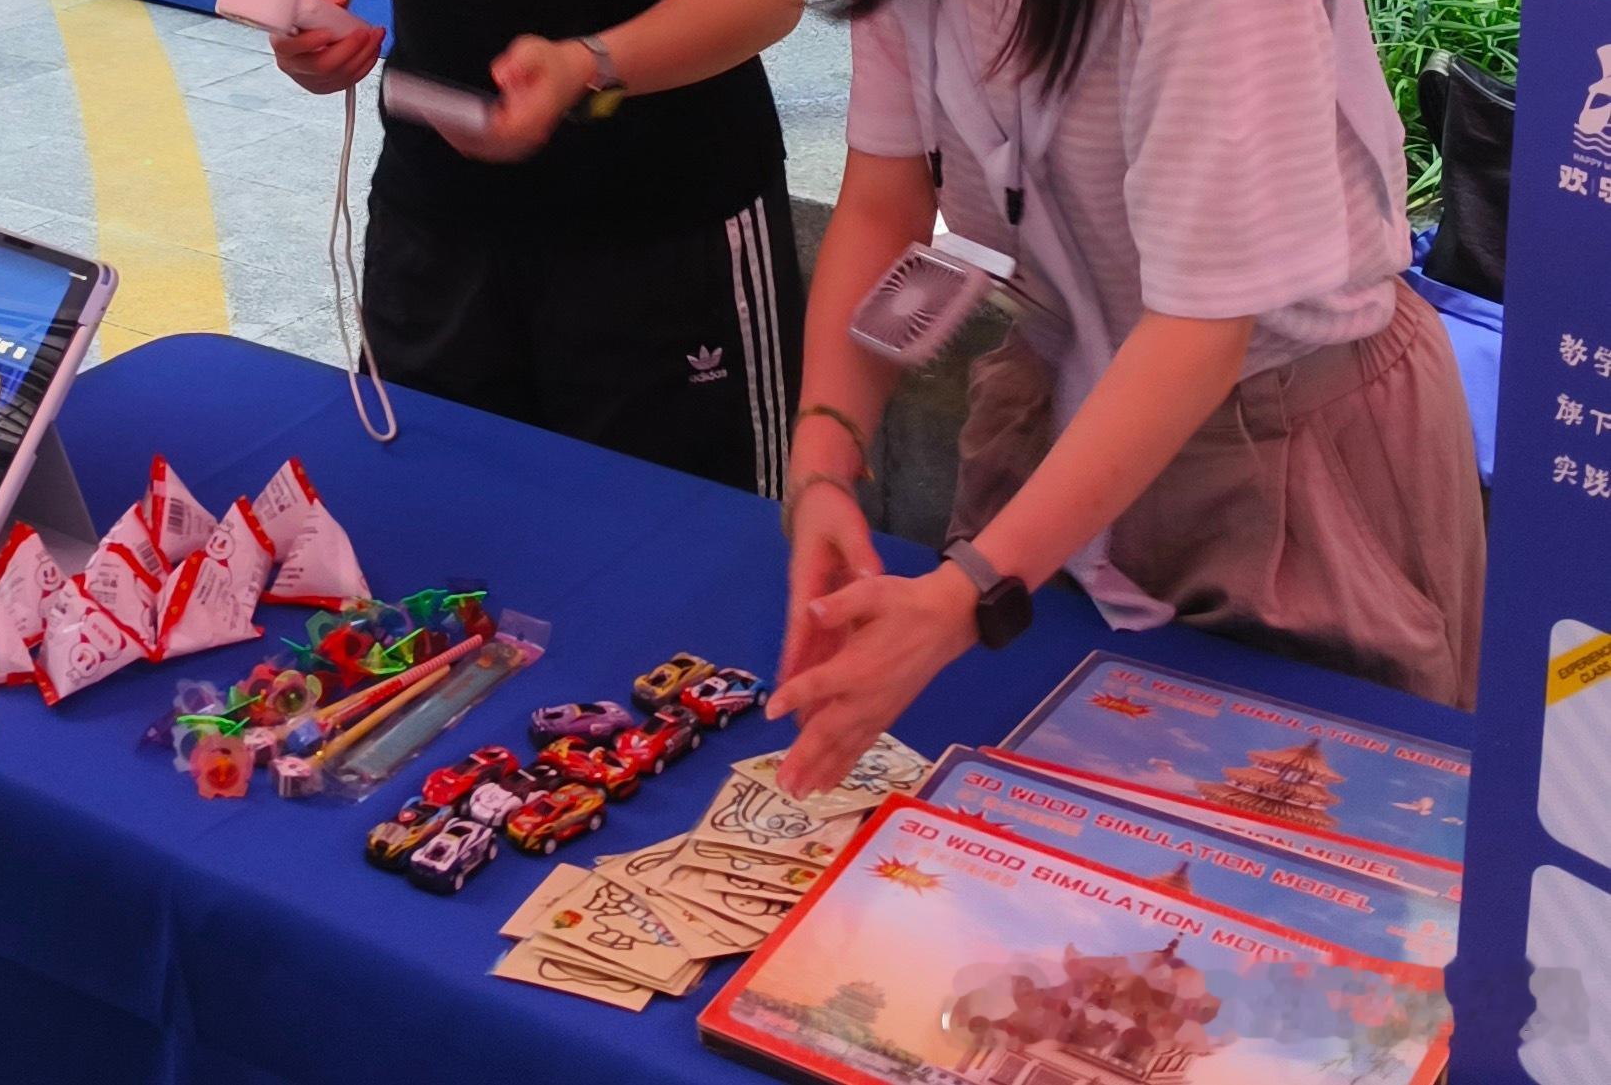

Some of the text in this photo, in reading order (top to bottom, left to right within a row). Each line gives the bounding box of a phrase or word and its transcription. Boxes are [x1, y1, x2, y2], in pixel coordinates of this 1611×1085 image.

[1230, 701, 1390, 754] SIMULATION
[899, 818, 940, 841] 3D
[946, 833, 1026, 872] WOOD
[1031, 865, 1205, 936] SIMULATION
[962, 771, 1003, 793] 3D
[1009, 785, 1089, 821] WOOD
[1094, 812, 1265, 879] SIMULATION
[1270, 868, 1376, 916] MODEL
